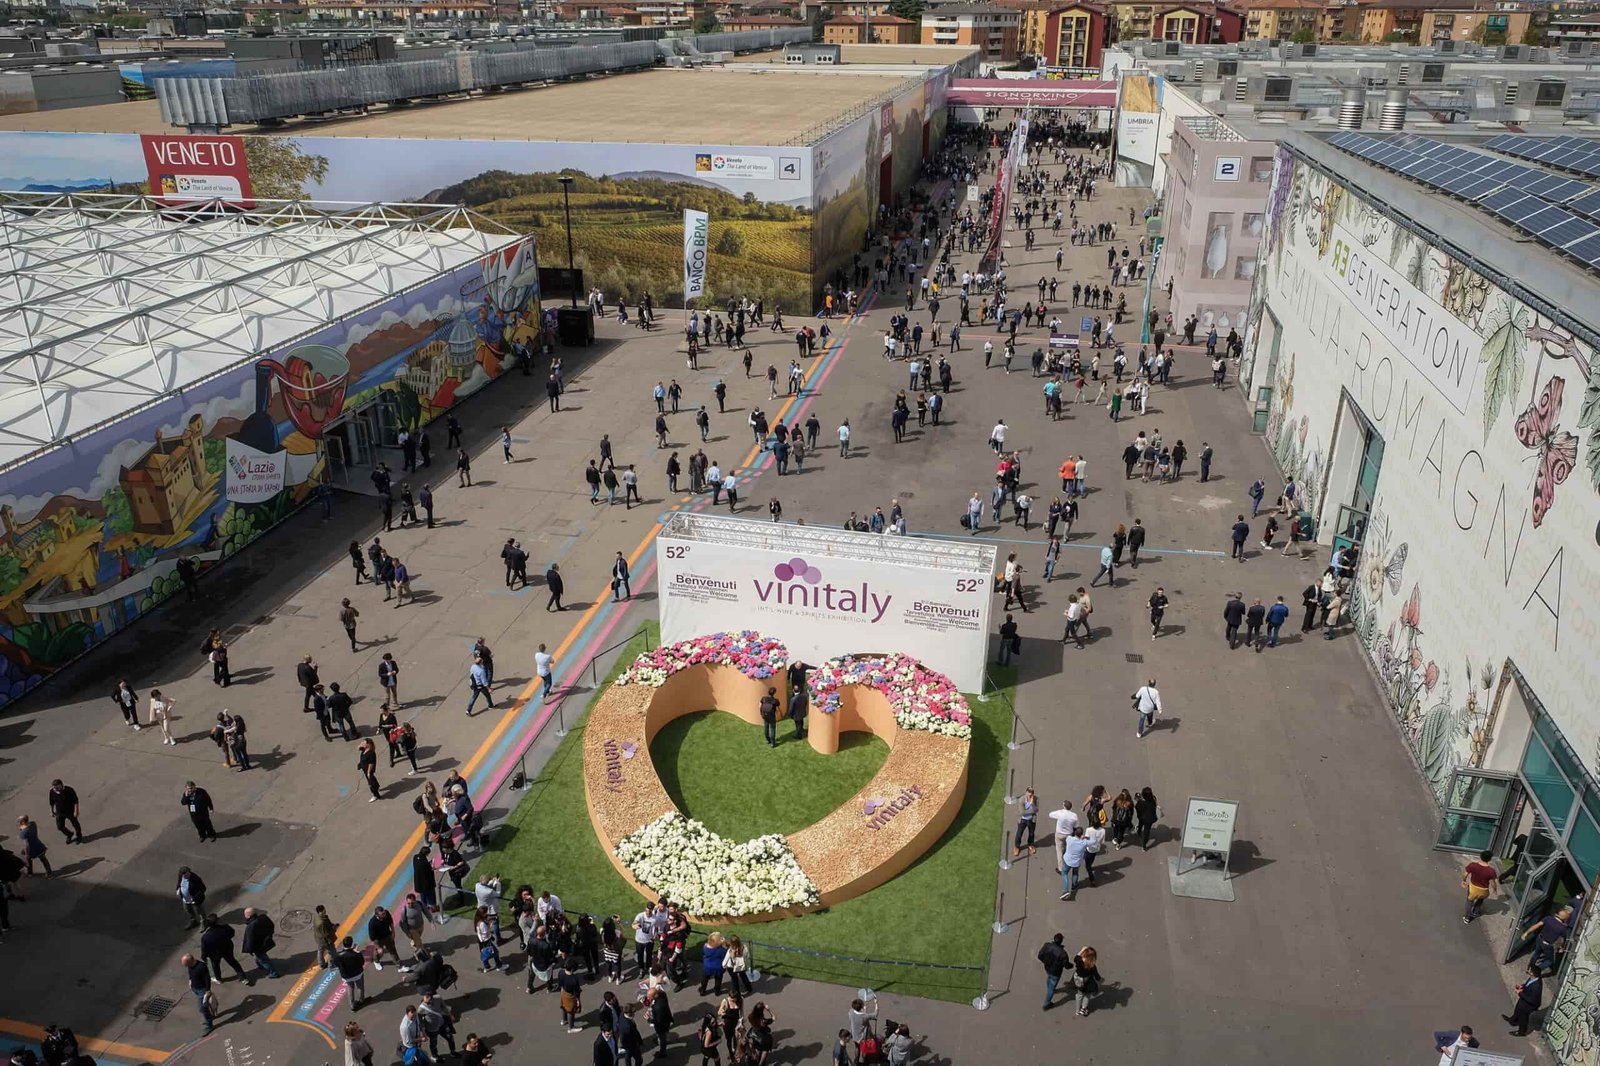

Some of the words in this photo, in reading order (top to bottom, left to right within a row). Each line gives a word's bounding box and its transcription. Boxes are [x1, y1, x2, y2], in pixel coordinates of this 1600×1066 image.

[985, 91, 1078, 99] SIGNORVINO
[152, 141, 236, 166] VENETO
[784, 163, 796, 174] 4
[1221, 163, 1235, 175] 2
[694, 218, 706, 247] BPM
[525, 250, 532, 262] A
[690, 249, 705, 292] BANCO
[227, 485, 239, 495] UNA
[240, 484, 257, 495] STORIA
[676, 574, 737, 590] Benvenuti
[709, 590, 738, 598] Welcome
[753, 579, 892, 624] vinitaly
[913, 602, 980, 618] Benvenuti
[948, 618, 980, 627] Welcome
[603, 738, 627, 793] vinitaly
[866, 783, 923, 831] vinitaly
[289, 977, 310, 997] Food
[329, 988, 346, 1004] Info
